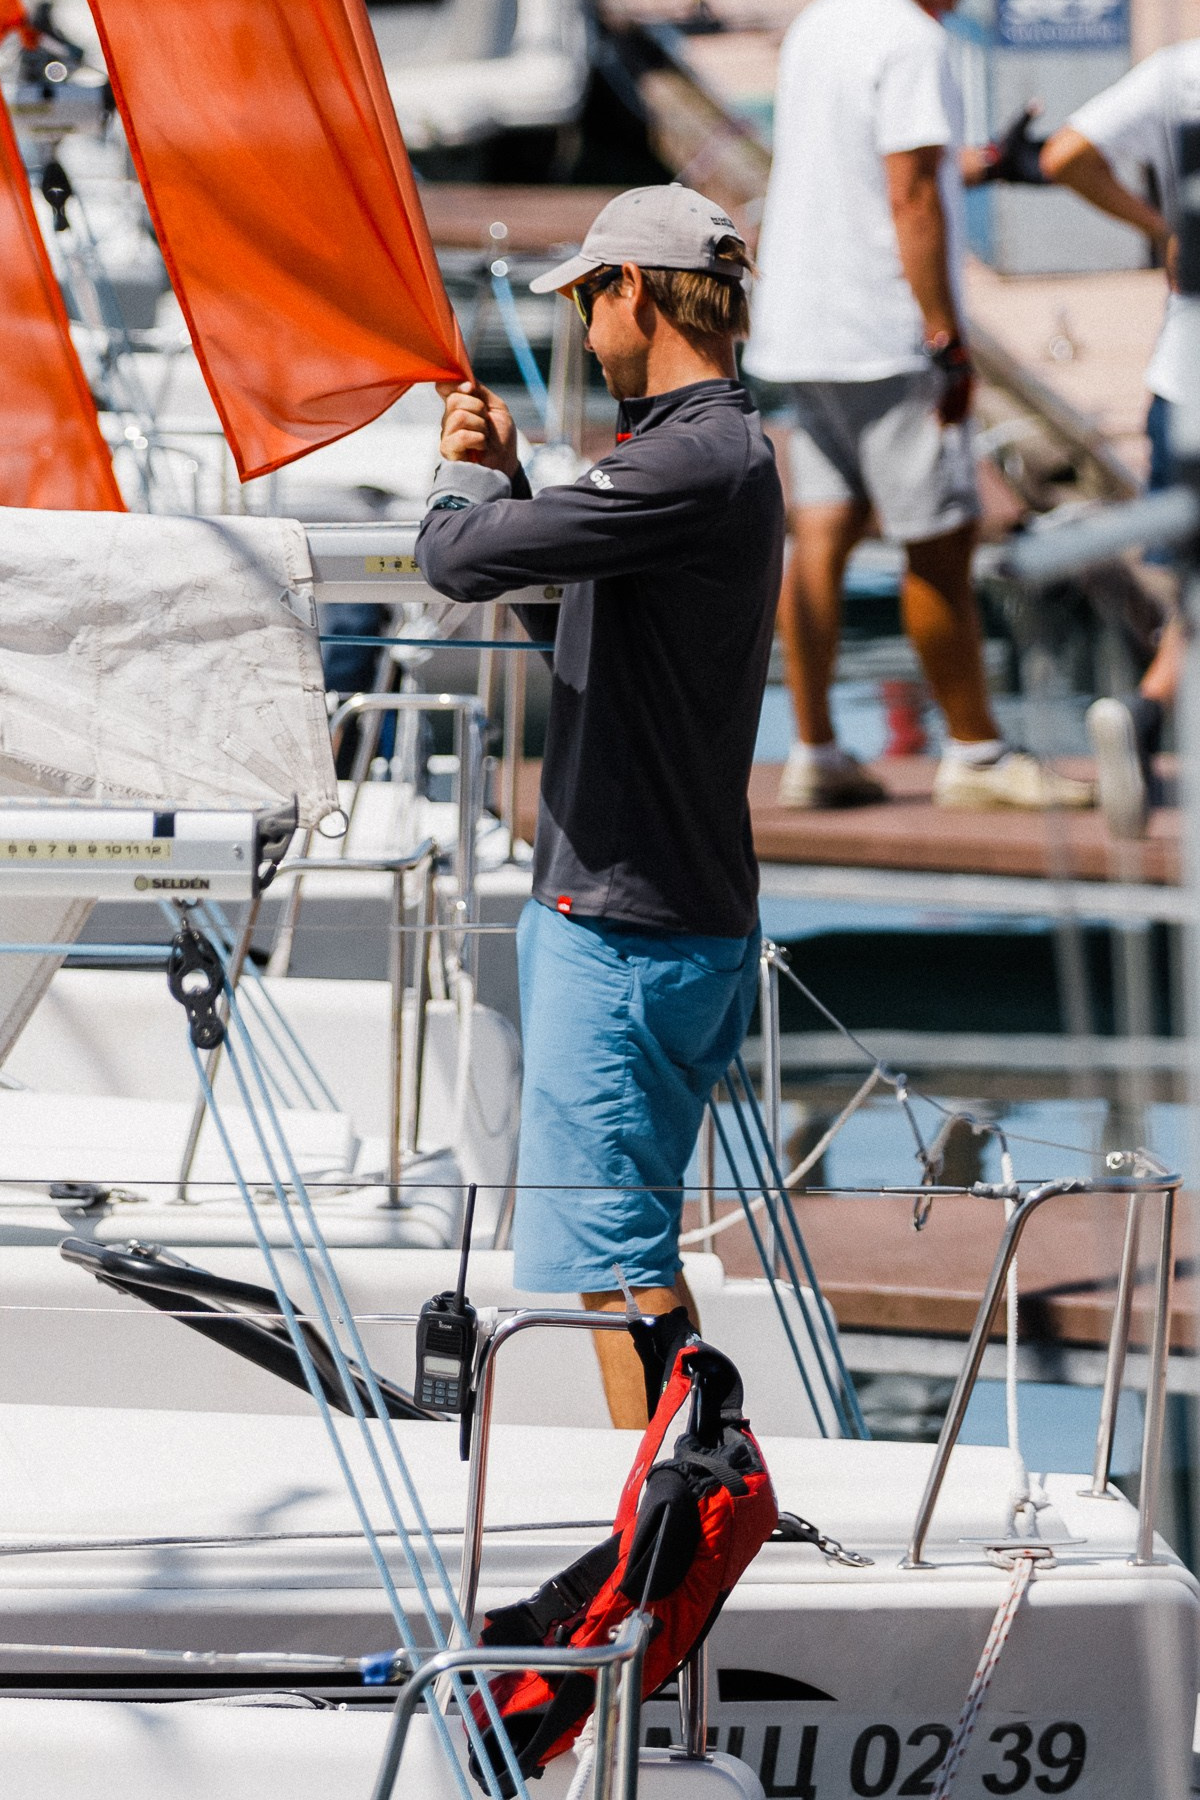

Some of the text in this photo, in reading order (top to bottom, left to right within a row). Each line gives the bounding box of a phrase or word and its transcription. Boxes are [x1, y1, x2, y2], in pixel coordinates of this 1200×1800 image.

[105, 844, 122, 854] 10
[126, 844, 139, 854] 11
[849, 1723, 955, 1797] 02
[981, 1721, 1088, 1796] 39
